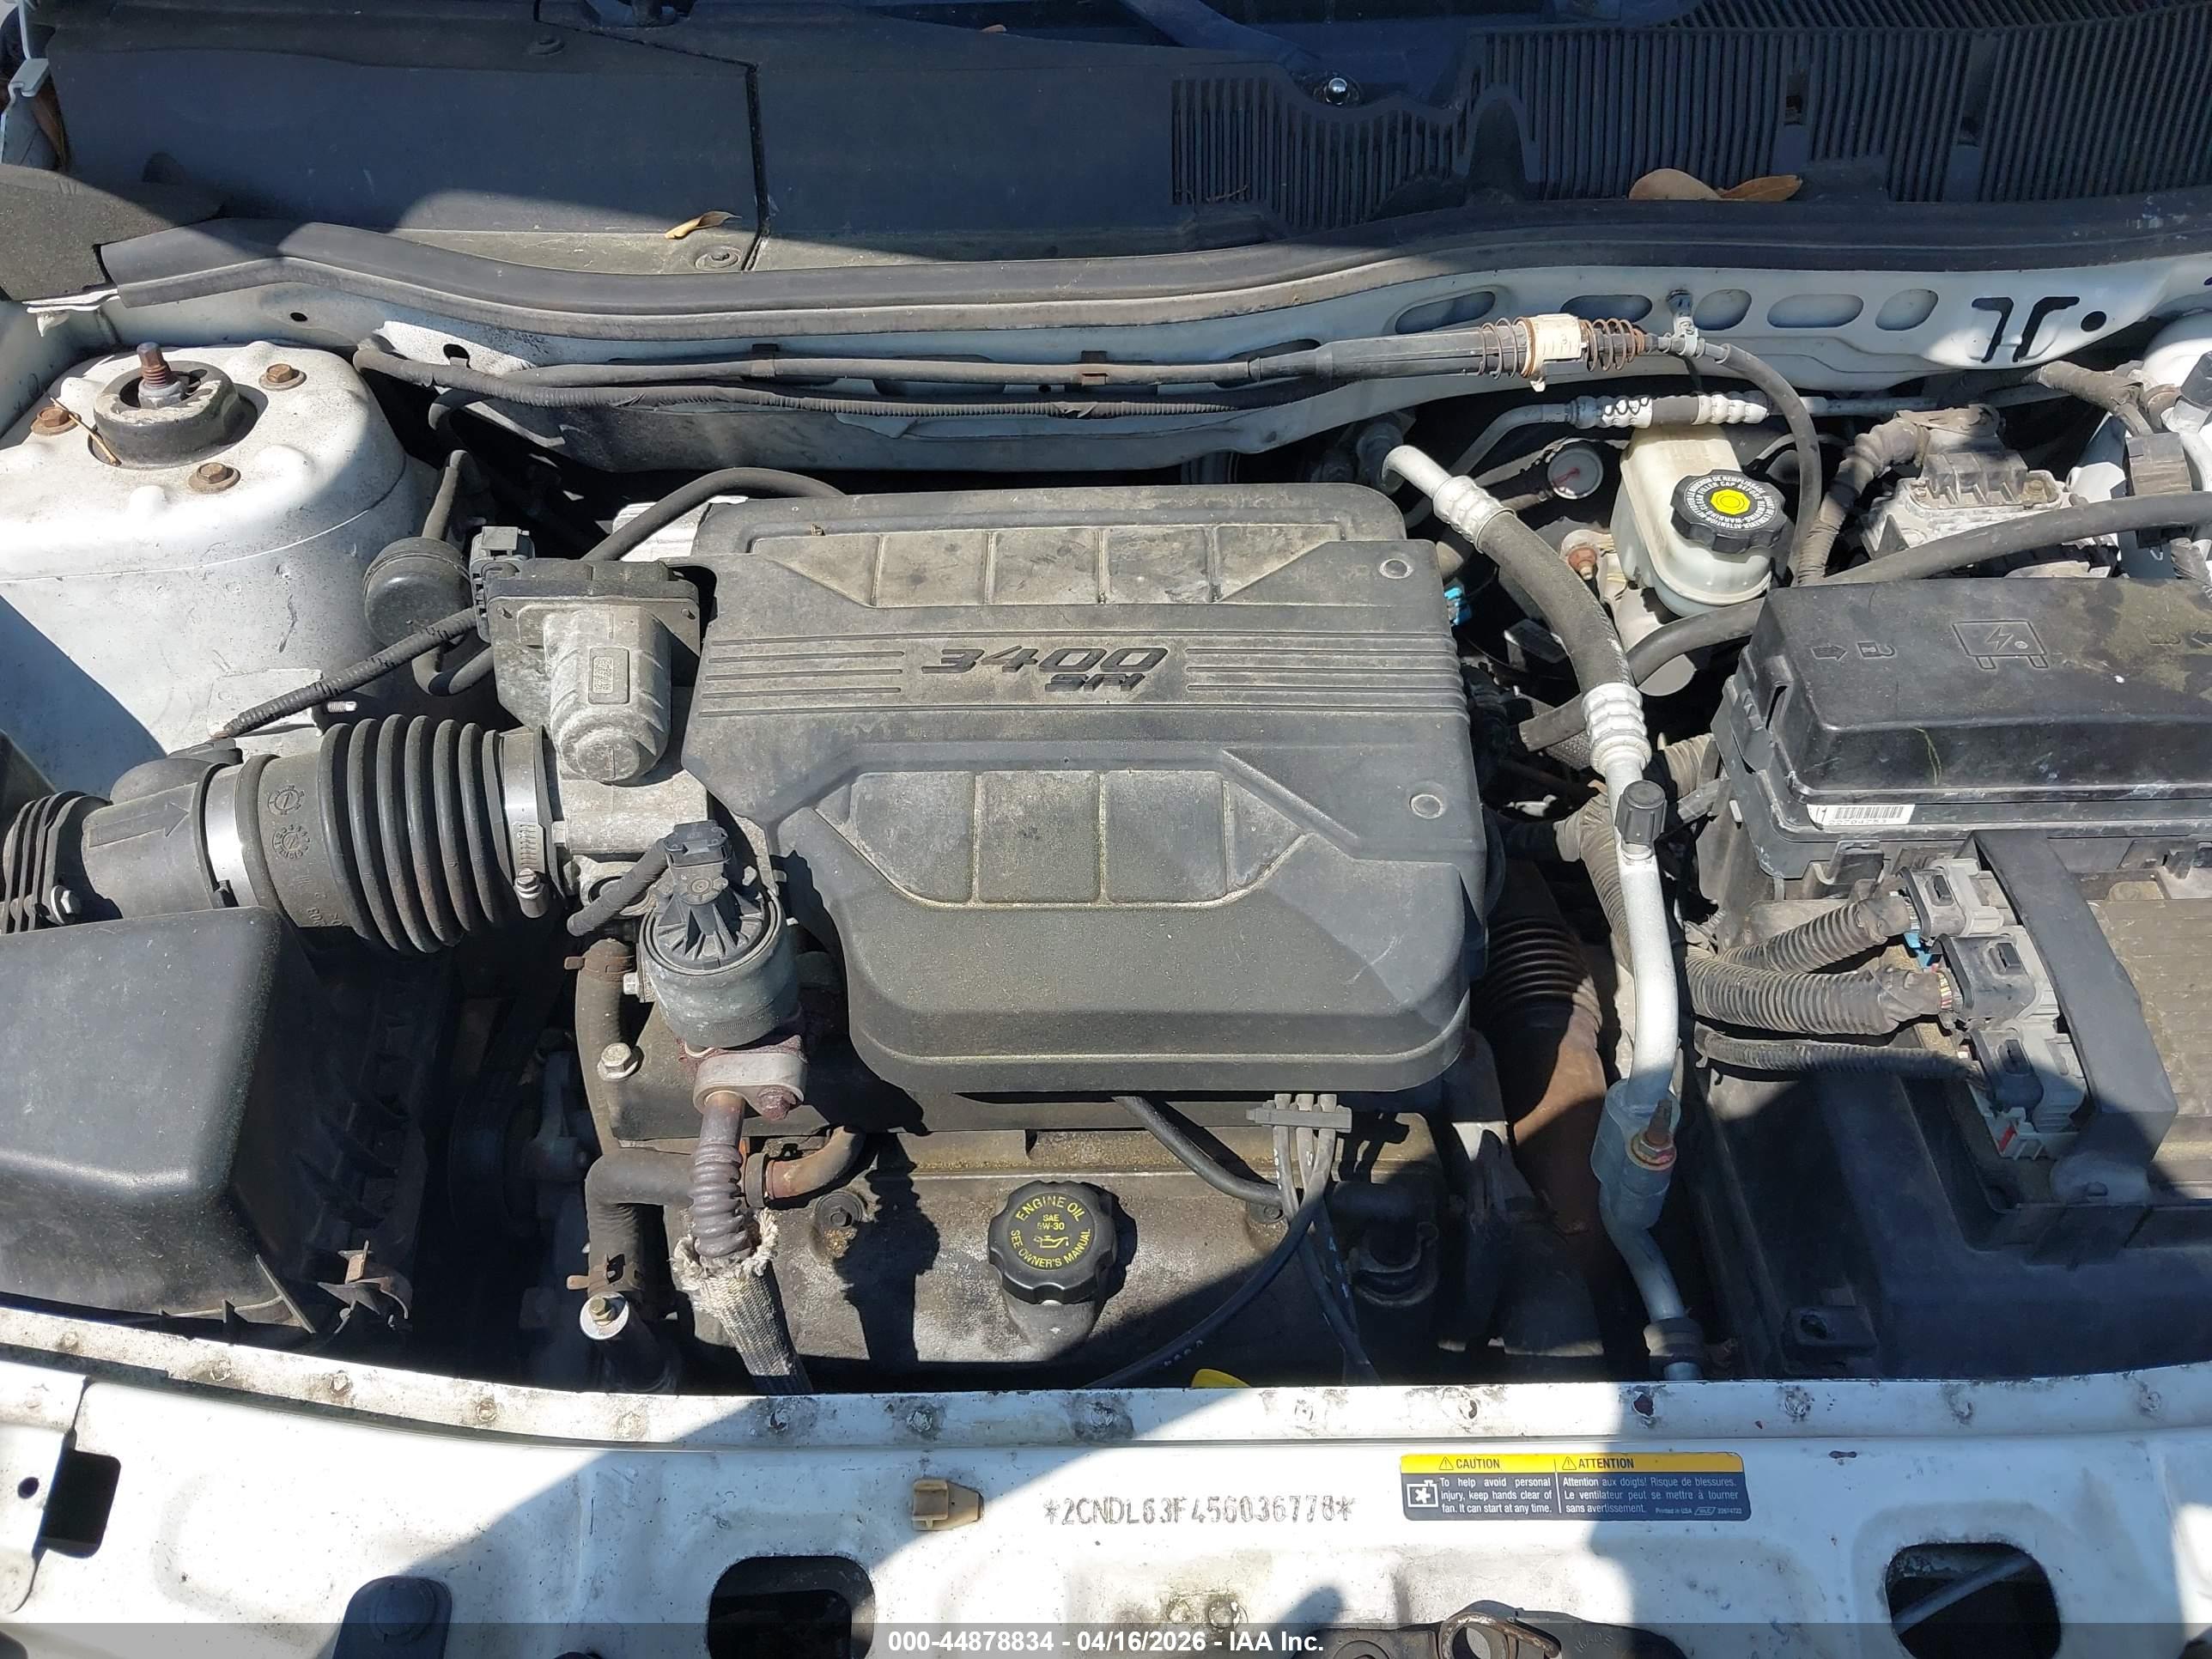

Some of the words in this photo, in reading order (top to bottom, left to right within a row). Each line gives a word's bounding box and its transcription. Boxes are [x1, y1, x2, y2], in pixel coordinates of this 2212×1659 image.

[921, 645, 1169, 674] 3400
[1015, 1195, 1066, 1222] ENGINE
[1066, 1203, 1086, 1222] OIL
[1042, 1213, 1060, 1222] SAE
[1011, 1230, 1024, 1249] SEE
[1018, 1248, 1062, 1268] OWNER'S
[1063, 1228, 1091, 1264] MANUAL
[1455, 1458, 1500, 1469] CAUTION
[1578, 1458, 1635, 1469] ATTENTION
[1440, 1477, 1450, 1487] To
[1457, 1477, 1476, 1489] help
[1484, 1477, 1507, 1487] avoid
[1515, 1477, 1551, 1489] personal
[1563, 1476, 1599, 1487] Attention
[1601, 1479, 1617, 1487] aux
[1620, 1476, 1647, 1489] doigts!
[1650, 1476, 1678, 1489] Risque
[1681, 1476, 1692, 1486] de
[1694, 1476, 1737, 1487] blessures.
[1441, 1490, 1466, 1503] injury,
[1468, 1490, 1489, 1503] keep
[1492, 1490, 1517, 1500] hands
[1520, 1490, 1540, 1500] clear
[1543, 1490, 1553, 1500] of
[1564, 1490, 1575, 1500] Le
[1579, 1490, 1623, 1500] ventilateur
[1627, 1491, 1647, 1502] peut
[1650, 1492, 1662, 1500] se
[1666, 1491, 1693, 1500] mettre
[1698, 1490, 1704, 1500] à
[1708, 1491, 1739, 1500] tourner
[1441, 1503, 1458, 1513] fan.
[1459, 1504, 1466, 1513] It
[1467, 1504, 1482, 1513] can
[1483, 1504, 1503, 1513] start
[1504, 1504, 1513, 1513] at
[1514, 1504, 1530, 1516] any
[1530, 1503, 1553, 1513] time.
[1587, 1503, 1647, 1514] avertissement.
